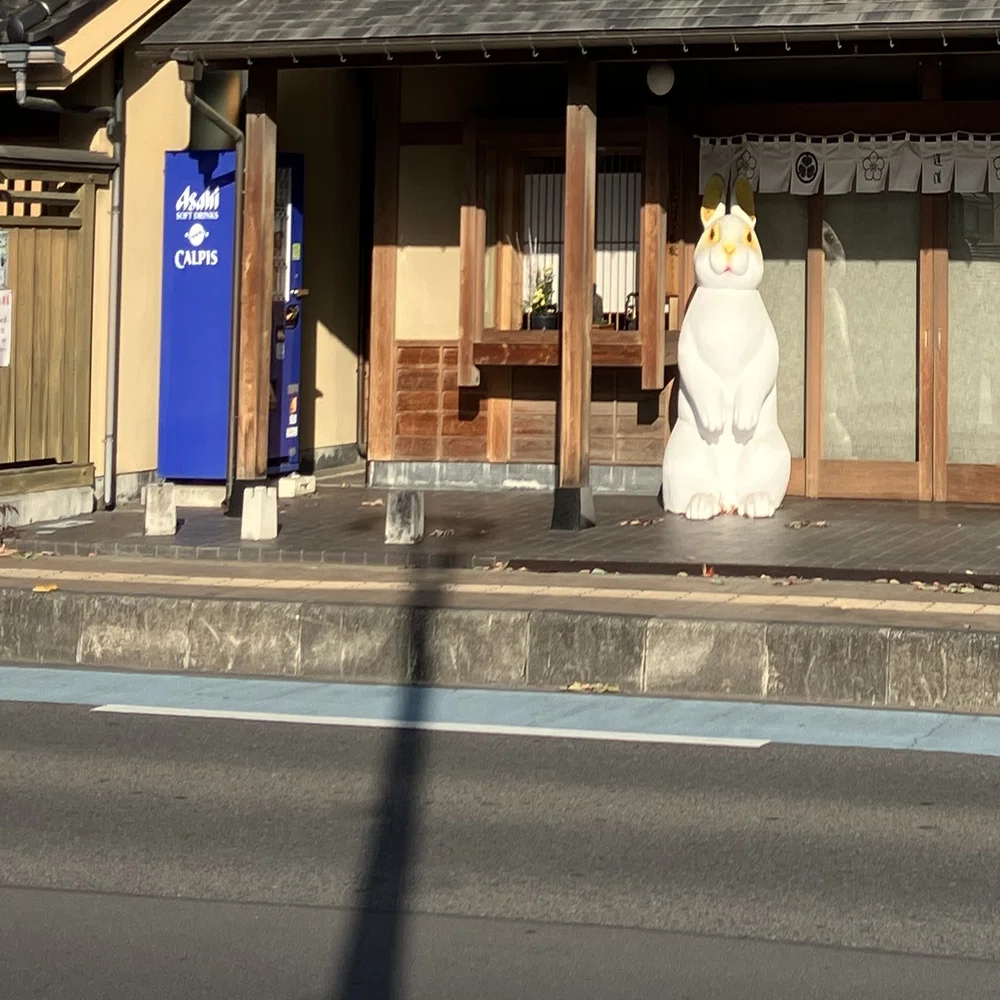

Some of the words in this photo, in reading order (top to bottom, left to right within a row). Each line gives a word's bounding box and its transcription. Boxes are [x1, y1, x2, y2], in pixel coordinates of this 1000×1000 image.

[176, 185, 220, 211] Asahi
[176, 211, 192, 220] SOFT
[193, 211, 219, 220] DRINKS
[174, 249, 218, 269] CALPIS
